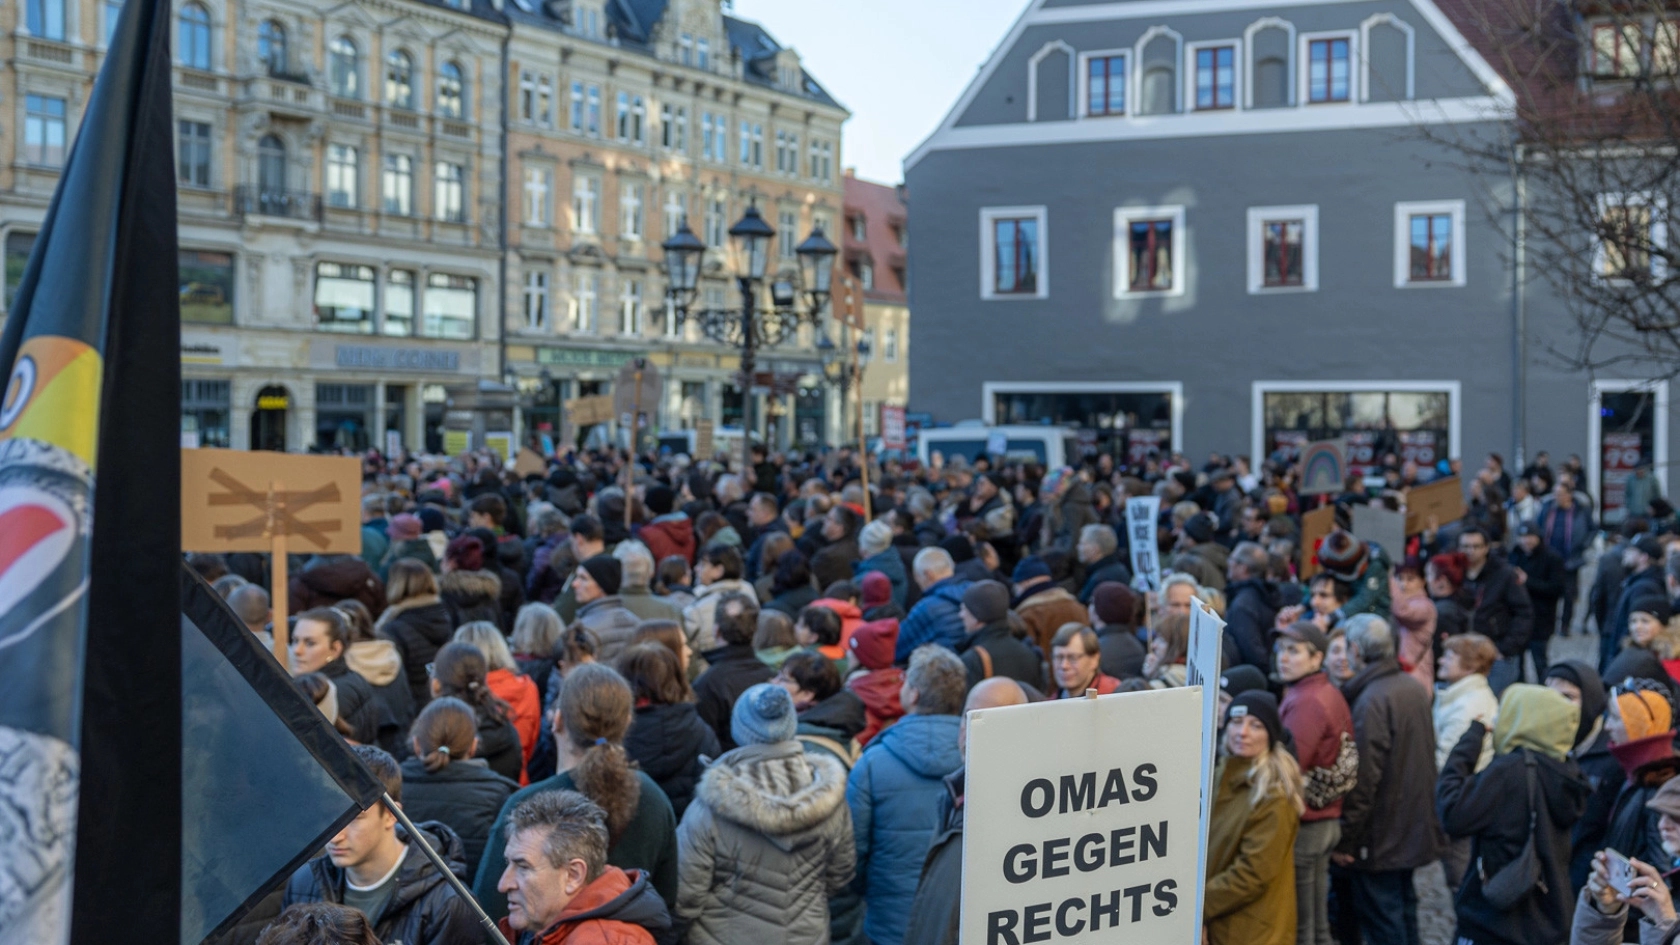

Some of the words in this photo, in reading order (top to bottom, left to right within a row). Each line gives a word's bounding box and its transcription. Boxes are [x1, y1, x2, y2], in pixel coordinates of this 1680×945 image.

[1019, 762, 1158, 819] OMAS
[1002, 820, 1169, 884] GEGEN
[986, 878, 1179, 945] RECHTS
